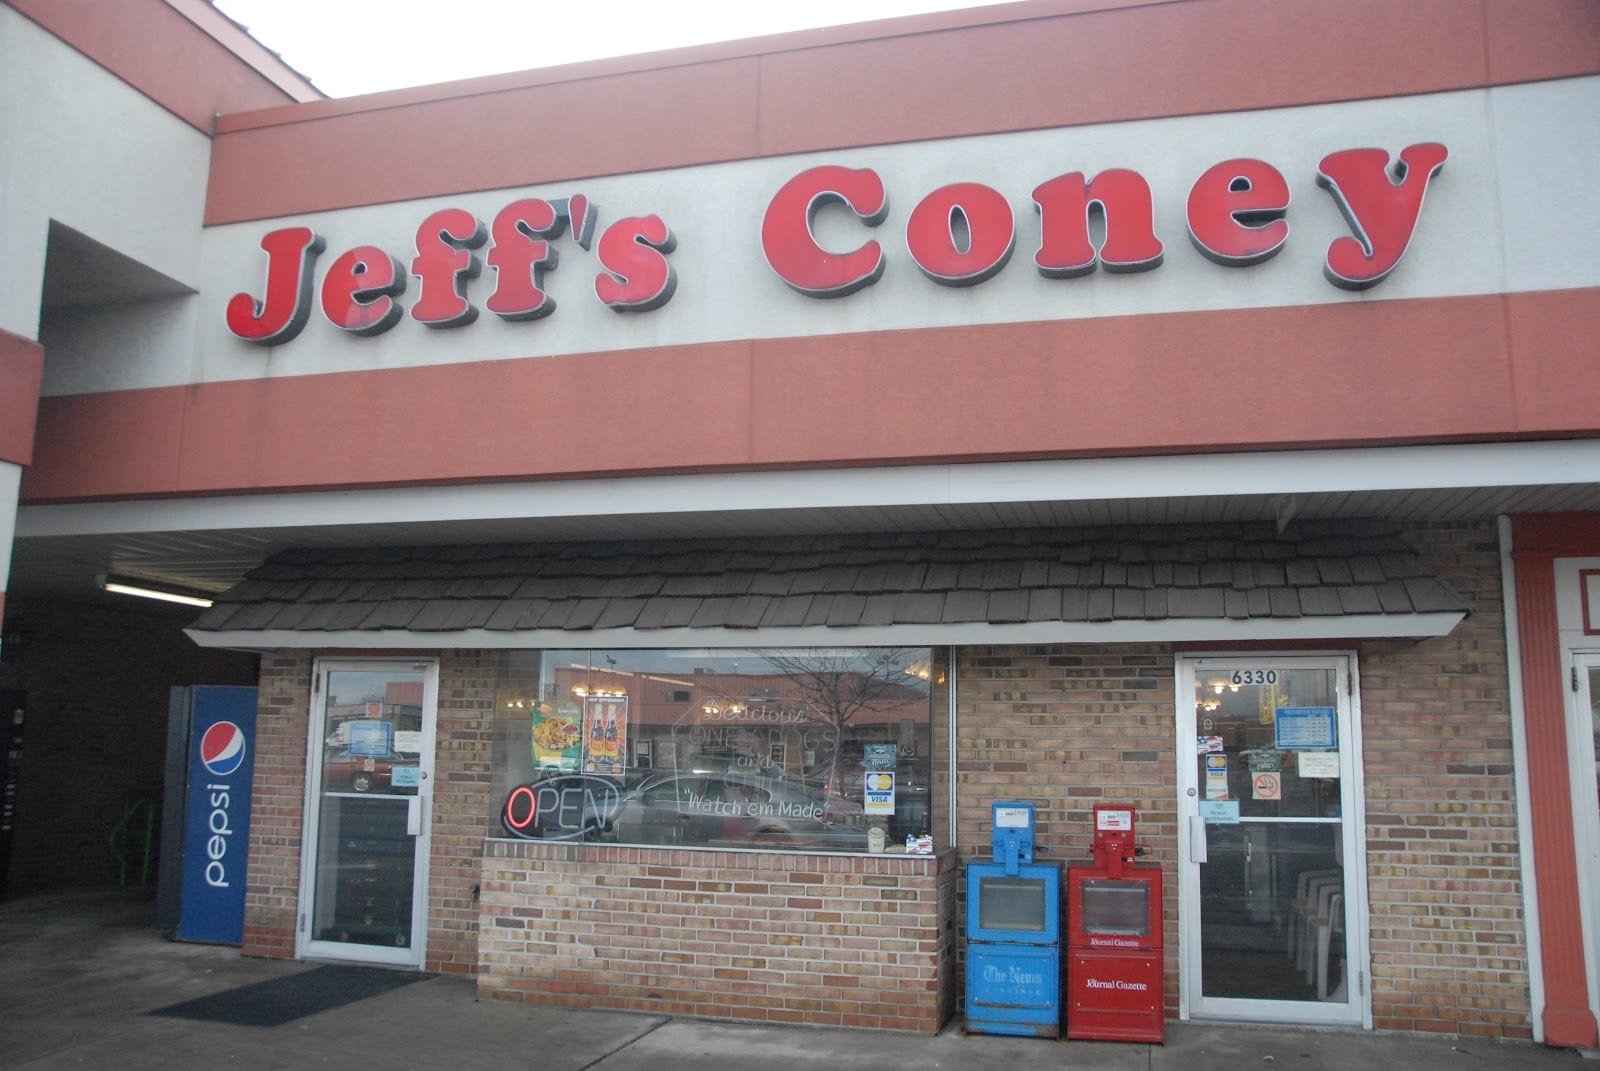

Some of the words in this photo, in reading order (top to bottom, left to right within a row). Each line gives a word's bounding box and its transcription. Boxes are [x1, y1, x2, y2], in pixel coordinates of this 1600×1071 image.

[226, 194, 677, 347] Jeff's
[761, 142, 1448, 298] Coney
[1232, 670, 1277, 684] 6330
[507, 787, 609, 829] OPEN
[205, 784, 233, 888] pepsi
[1090, 938, 1114, 946] Journal
[1114, 939, 1140, 947] Gazette
[983, 964, 1007, 983] The
[1009, 965, 1042, 985] News
[1086, 978, 1115, 989] Journal
[1115, 980, 1147, 991] Gazette
